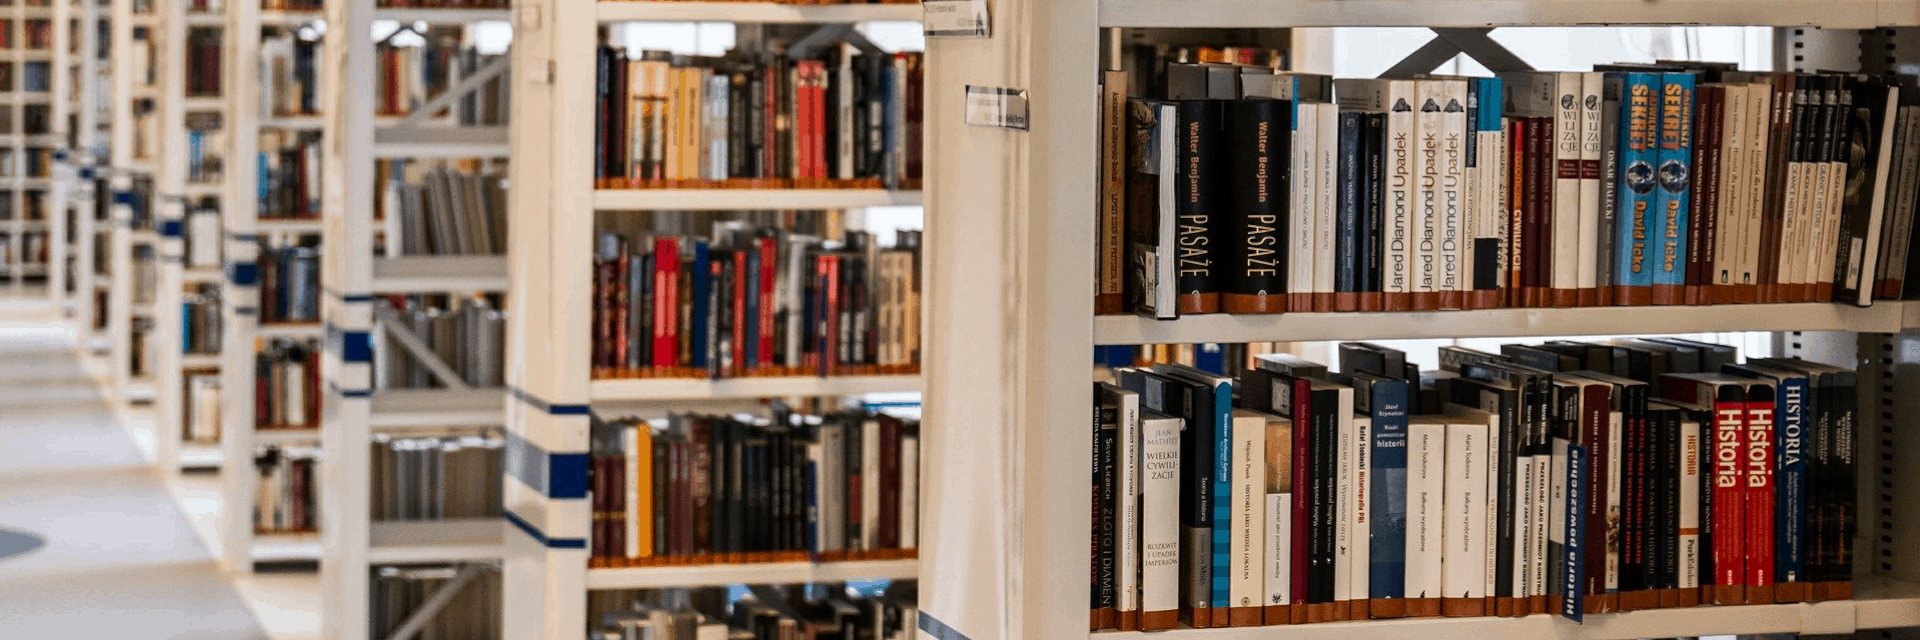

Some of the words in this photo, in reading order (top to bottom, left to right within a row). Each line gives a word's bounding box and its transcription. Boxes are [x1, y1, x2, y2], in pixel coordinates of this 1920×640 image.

[1563, 132, 1576, 140] ZA
[1629, 84, 1649, 152] SEKRET
[1662, 83, 1682, 151] SEKRET
[1190, 122, 1199, 153] Walter
[1258, 122, 1268, 153] Walter
[1560, 142, 1579, 152] CJE
[1584, 143, 1601, 153] CJE
[1587, 133, 1599, 141] ZA
[1188, 156, 1199, 202] Benjamin
[1257, 156, 1268, 202] Benjamin
[1393, 132, 1408, 188] Upadek
[1422, 133, 1437, 188] Upadek
[1444, 133, 1461, 188] Upadek
[1607, 150, 1615, 179] OSKAR
[1789, 164, 1798, 196] GRANICE
[1818, 164, 1826, 196] GRANICE
[1605, 182, 1614, 219] HALECKI
[1632, 200, 1647, 239] David
[1664, 199, 1680, 238] David
[1391, 190, 1405, 251] Diamond
[1420, 190, 1434, 251] Diamond
[1443, 190, 1456, 251] Diamond
[1180, 214, 1212, 276] PASAŻE
[1248, 214, 1279, 276] PASAŻE
[1512, 210, 1522, 271] CYWILIZACJE
[1631, 243, 1645, 273] Icke
[1664, 241, 1678, 272] Icke
[1391, 254, 1404, 293] Jared
[1420, 254, 1434, 293] Jared
[1442, 254, 1455, 291] Jared
[1785, 385, 1801, 465] HISTORIA
[1105, 438, 1113, 462] SILVIA
[1147, 451, 1178, 459] WIELKIE
[1147, 462, 1178, 470] CYWILI-
[1687, 435, 1696, 475] HISTORIA
[1719, 410, 1742, 488] Historia
[1749, 409, 1772, 487] Historia
[1105, 465, 1113, 500] LIEBRICH
[1152, 471, 1174, 480] ZACJE
[1570, 450, 1579, 547] powszechna
[1104, 508, 1112, 546] ZŁOTO
[1148, 542, 1176, 550] ROZKWIT
[1152, 550, 1177, 558] UPADEK
[1566, 562, 1576, 614] Historia
